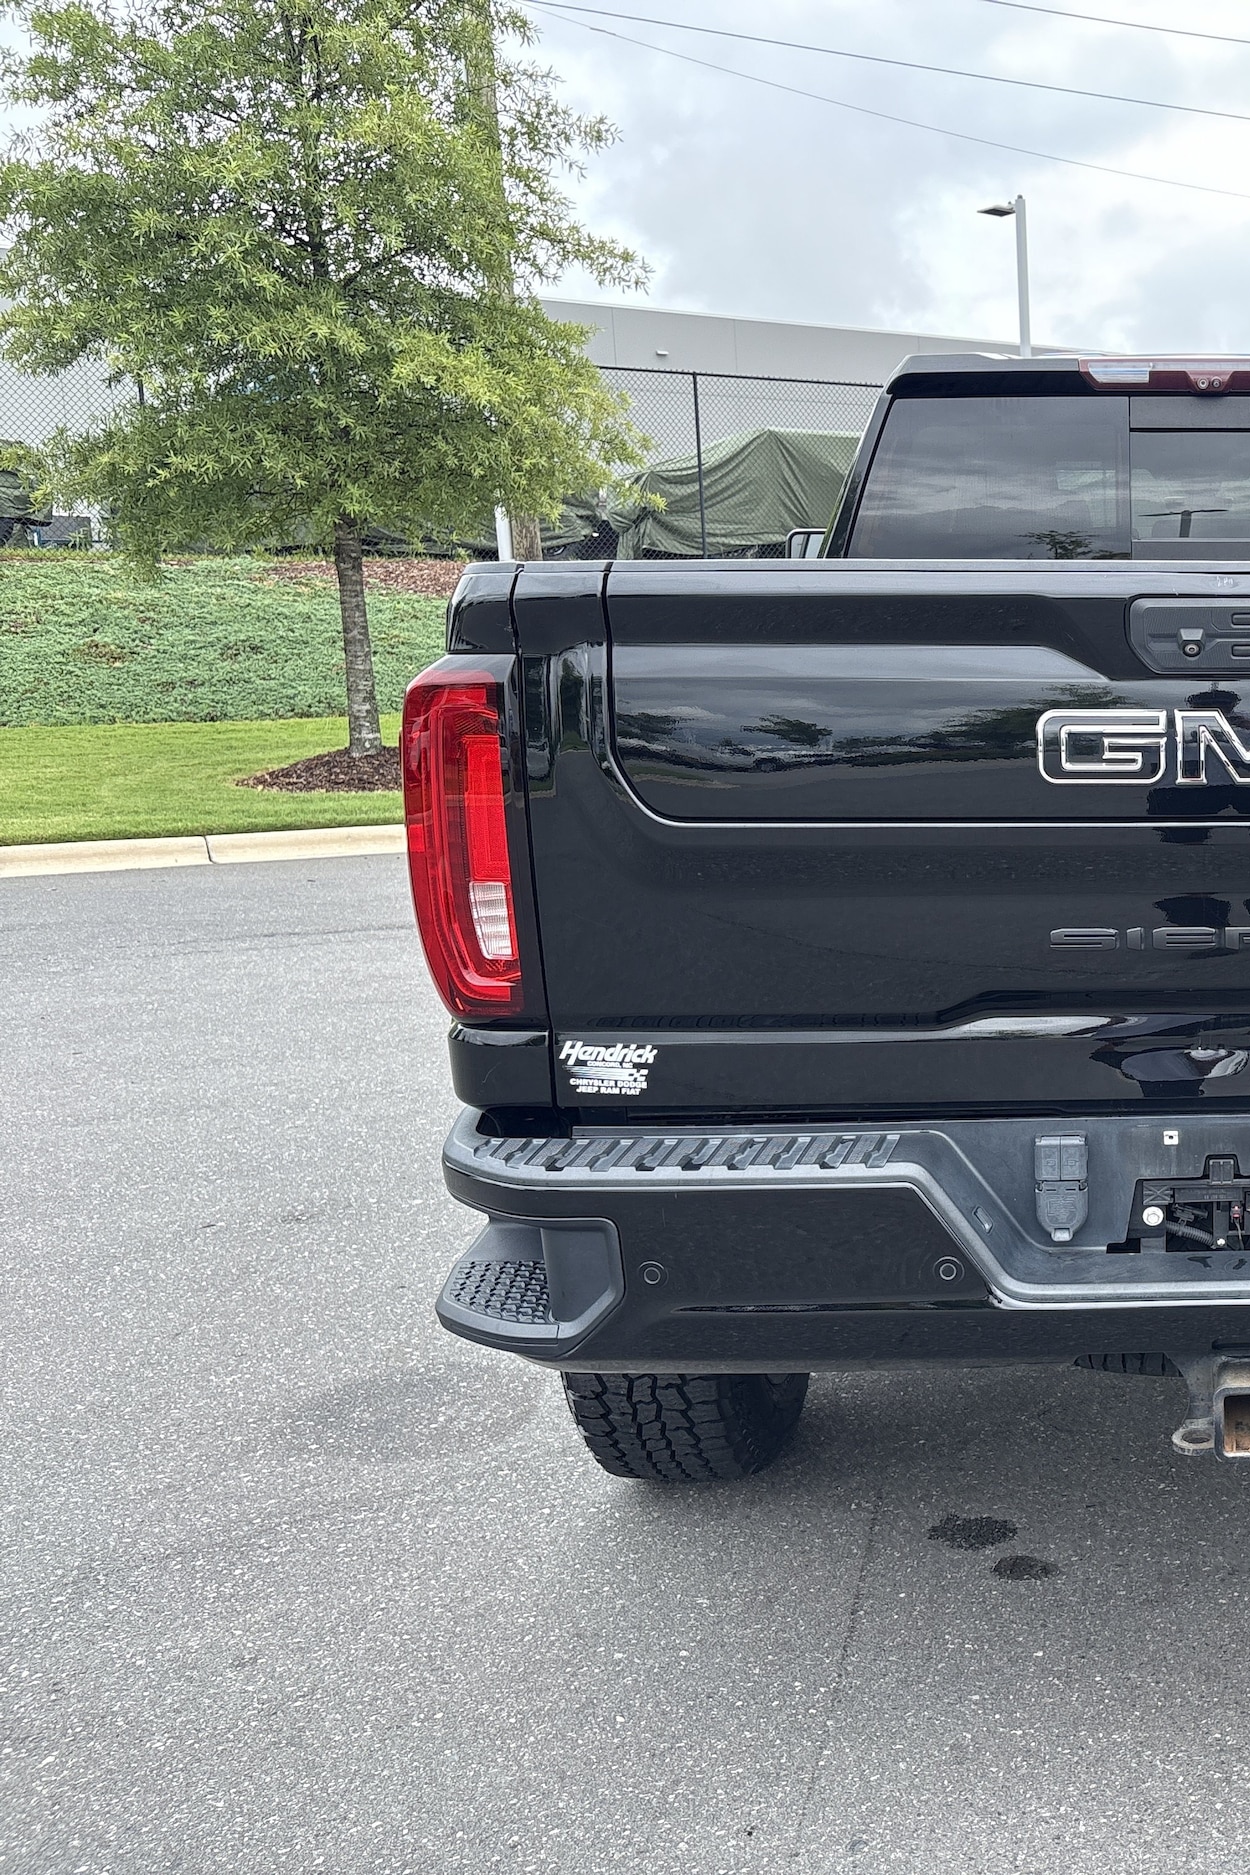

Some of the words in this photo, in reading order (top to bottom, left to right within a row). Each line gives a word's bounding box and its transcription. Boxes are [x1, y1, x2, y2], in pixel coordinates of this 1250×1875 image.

[559, 1041, 658, 1066] Hendrick
[569, 1078, 616, 1087] CHRYSLER
[617, 1081, 648, 1089] DODGE
